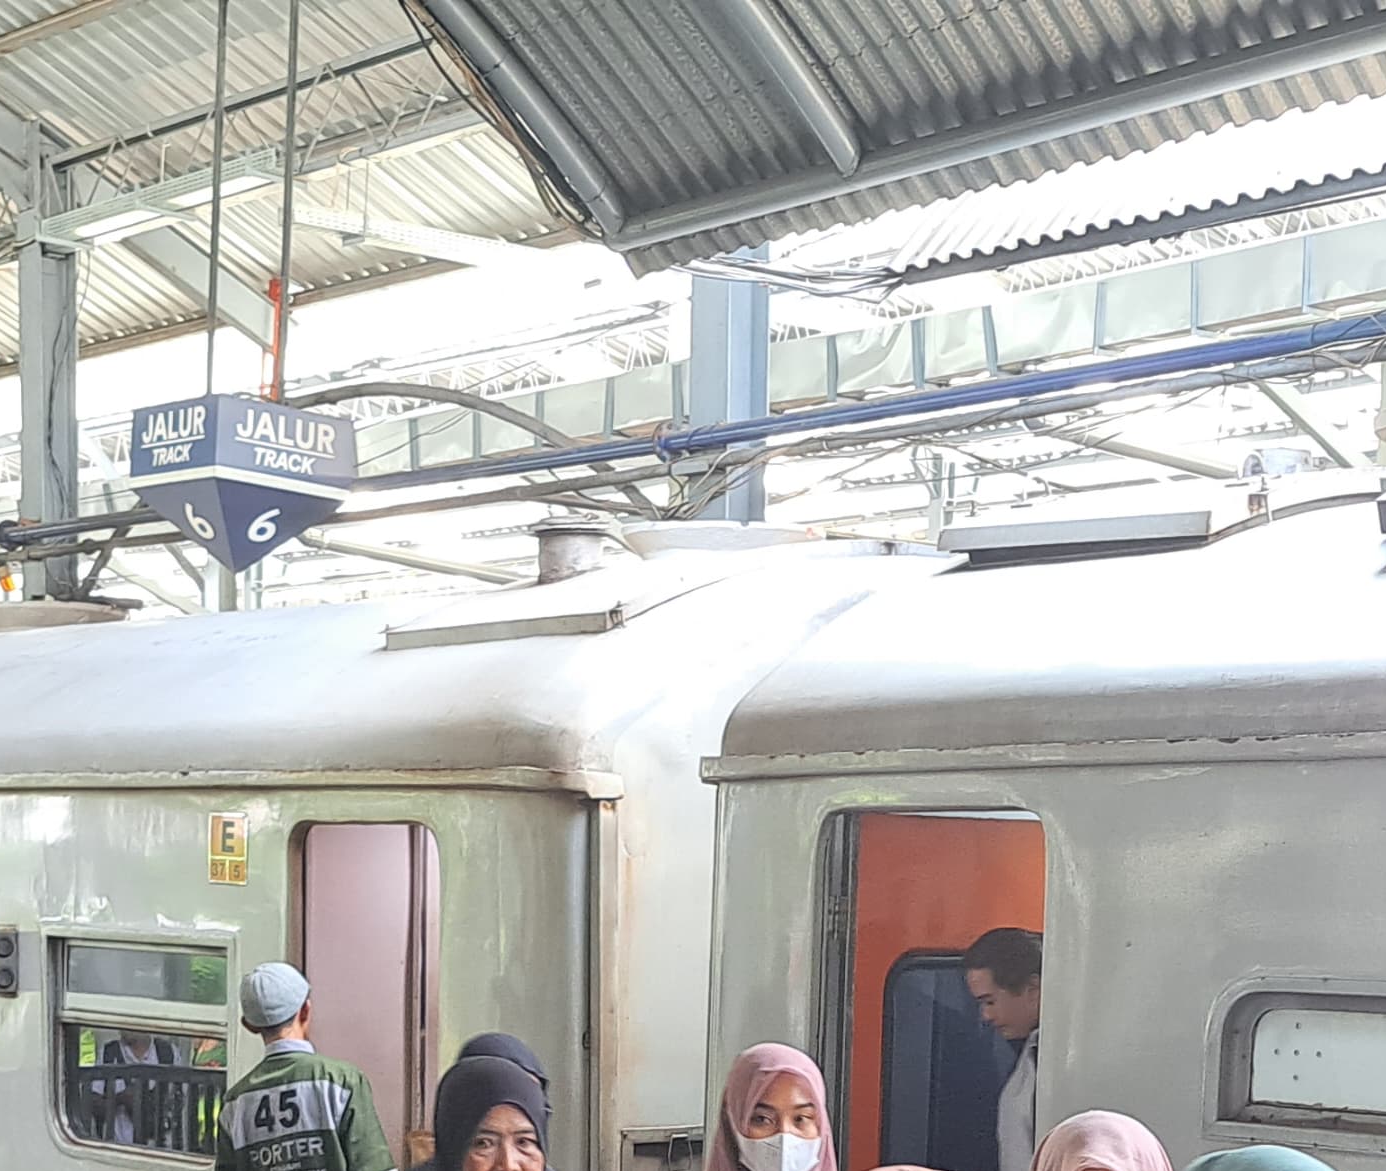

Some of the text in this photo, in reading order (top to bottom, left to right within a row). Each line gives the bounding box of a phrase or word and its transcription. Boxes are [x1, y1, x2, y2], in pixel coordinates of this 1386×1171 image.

[141, 405, 207, 444] JALUR
[236, 409, 336, 454] JALUR
[152, 442, 193, 467] TRACK
[253, 447, 317, 476] TRACK
[184, 503, 215, 541] 6
[247, 508, 283, 543] 6
[221, 820, 235, 853] E
[254, 1089, 301, 1133] 45
[248, 1136, 325, 1166] PORTER
